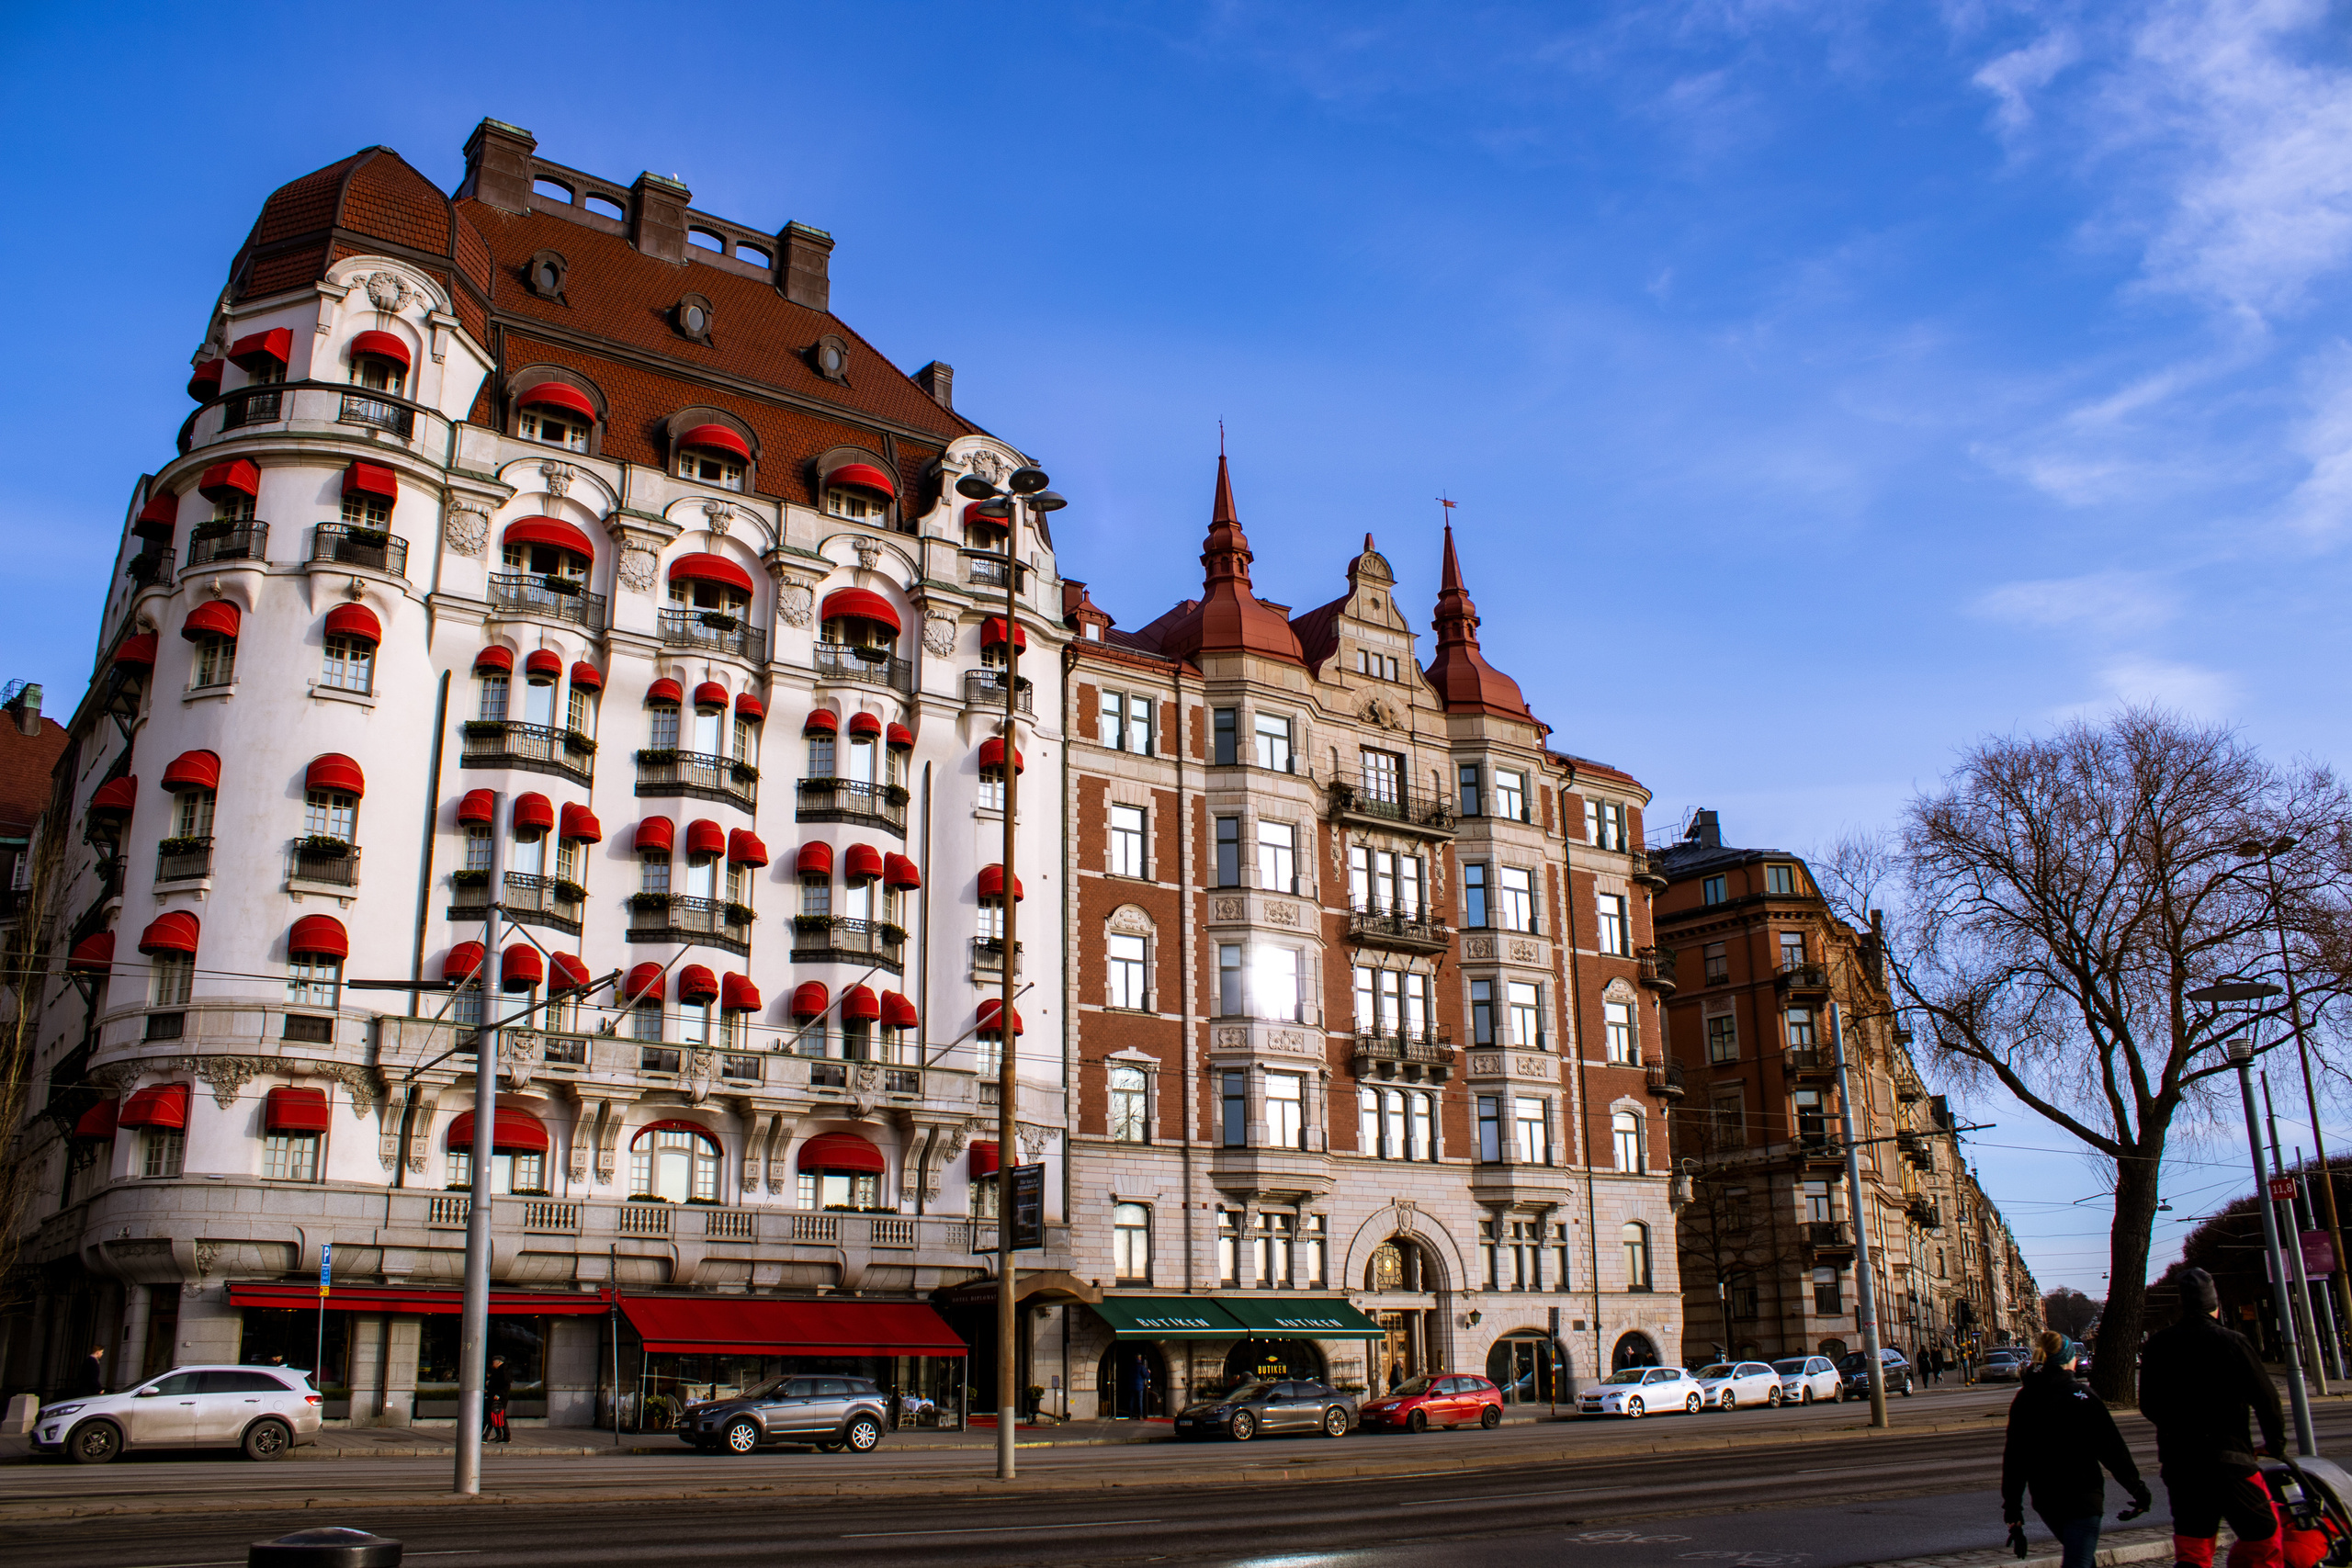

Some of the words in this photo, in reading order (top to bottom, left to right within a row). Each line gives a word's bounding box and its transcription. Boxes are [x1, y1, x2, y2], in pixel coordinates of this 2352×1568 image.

[2272, 1182, 2293, 1195] 11,8
[323, 1247, 330, 1263] P
[1385, 1258, 1392, 1272] 9
[1136, 1317, 1211, 1327] BUTIKEN
[1274, 1318, 1343, 1327] BUTIKEN
[1258, 1364, 1287, 1374] BUTIKEN
